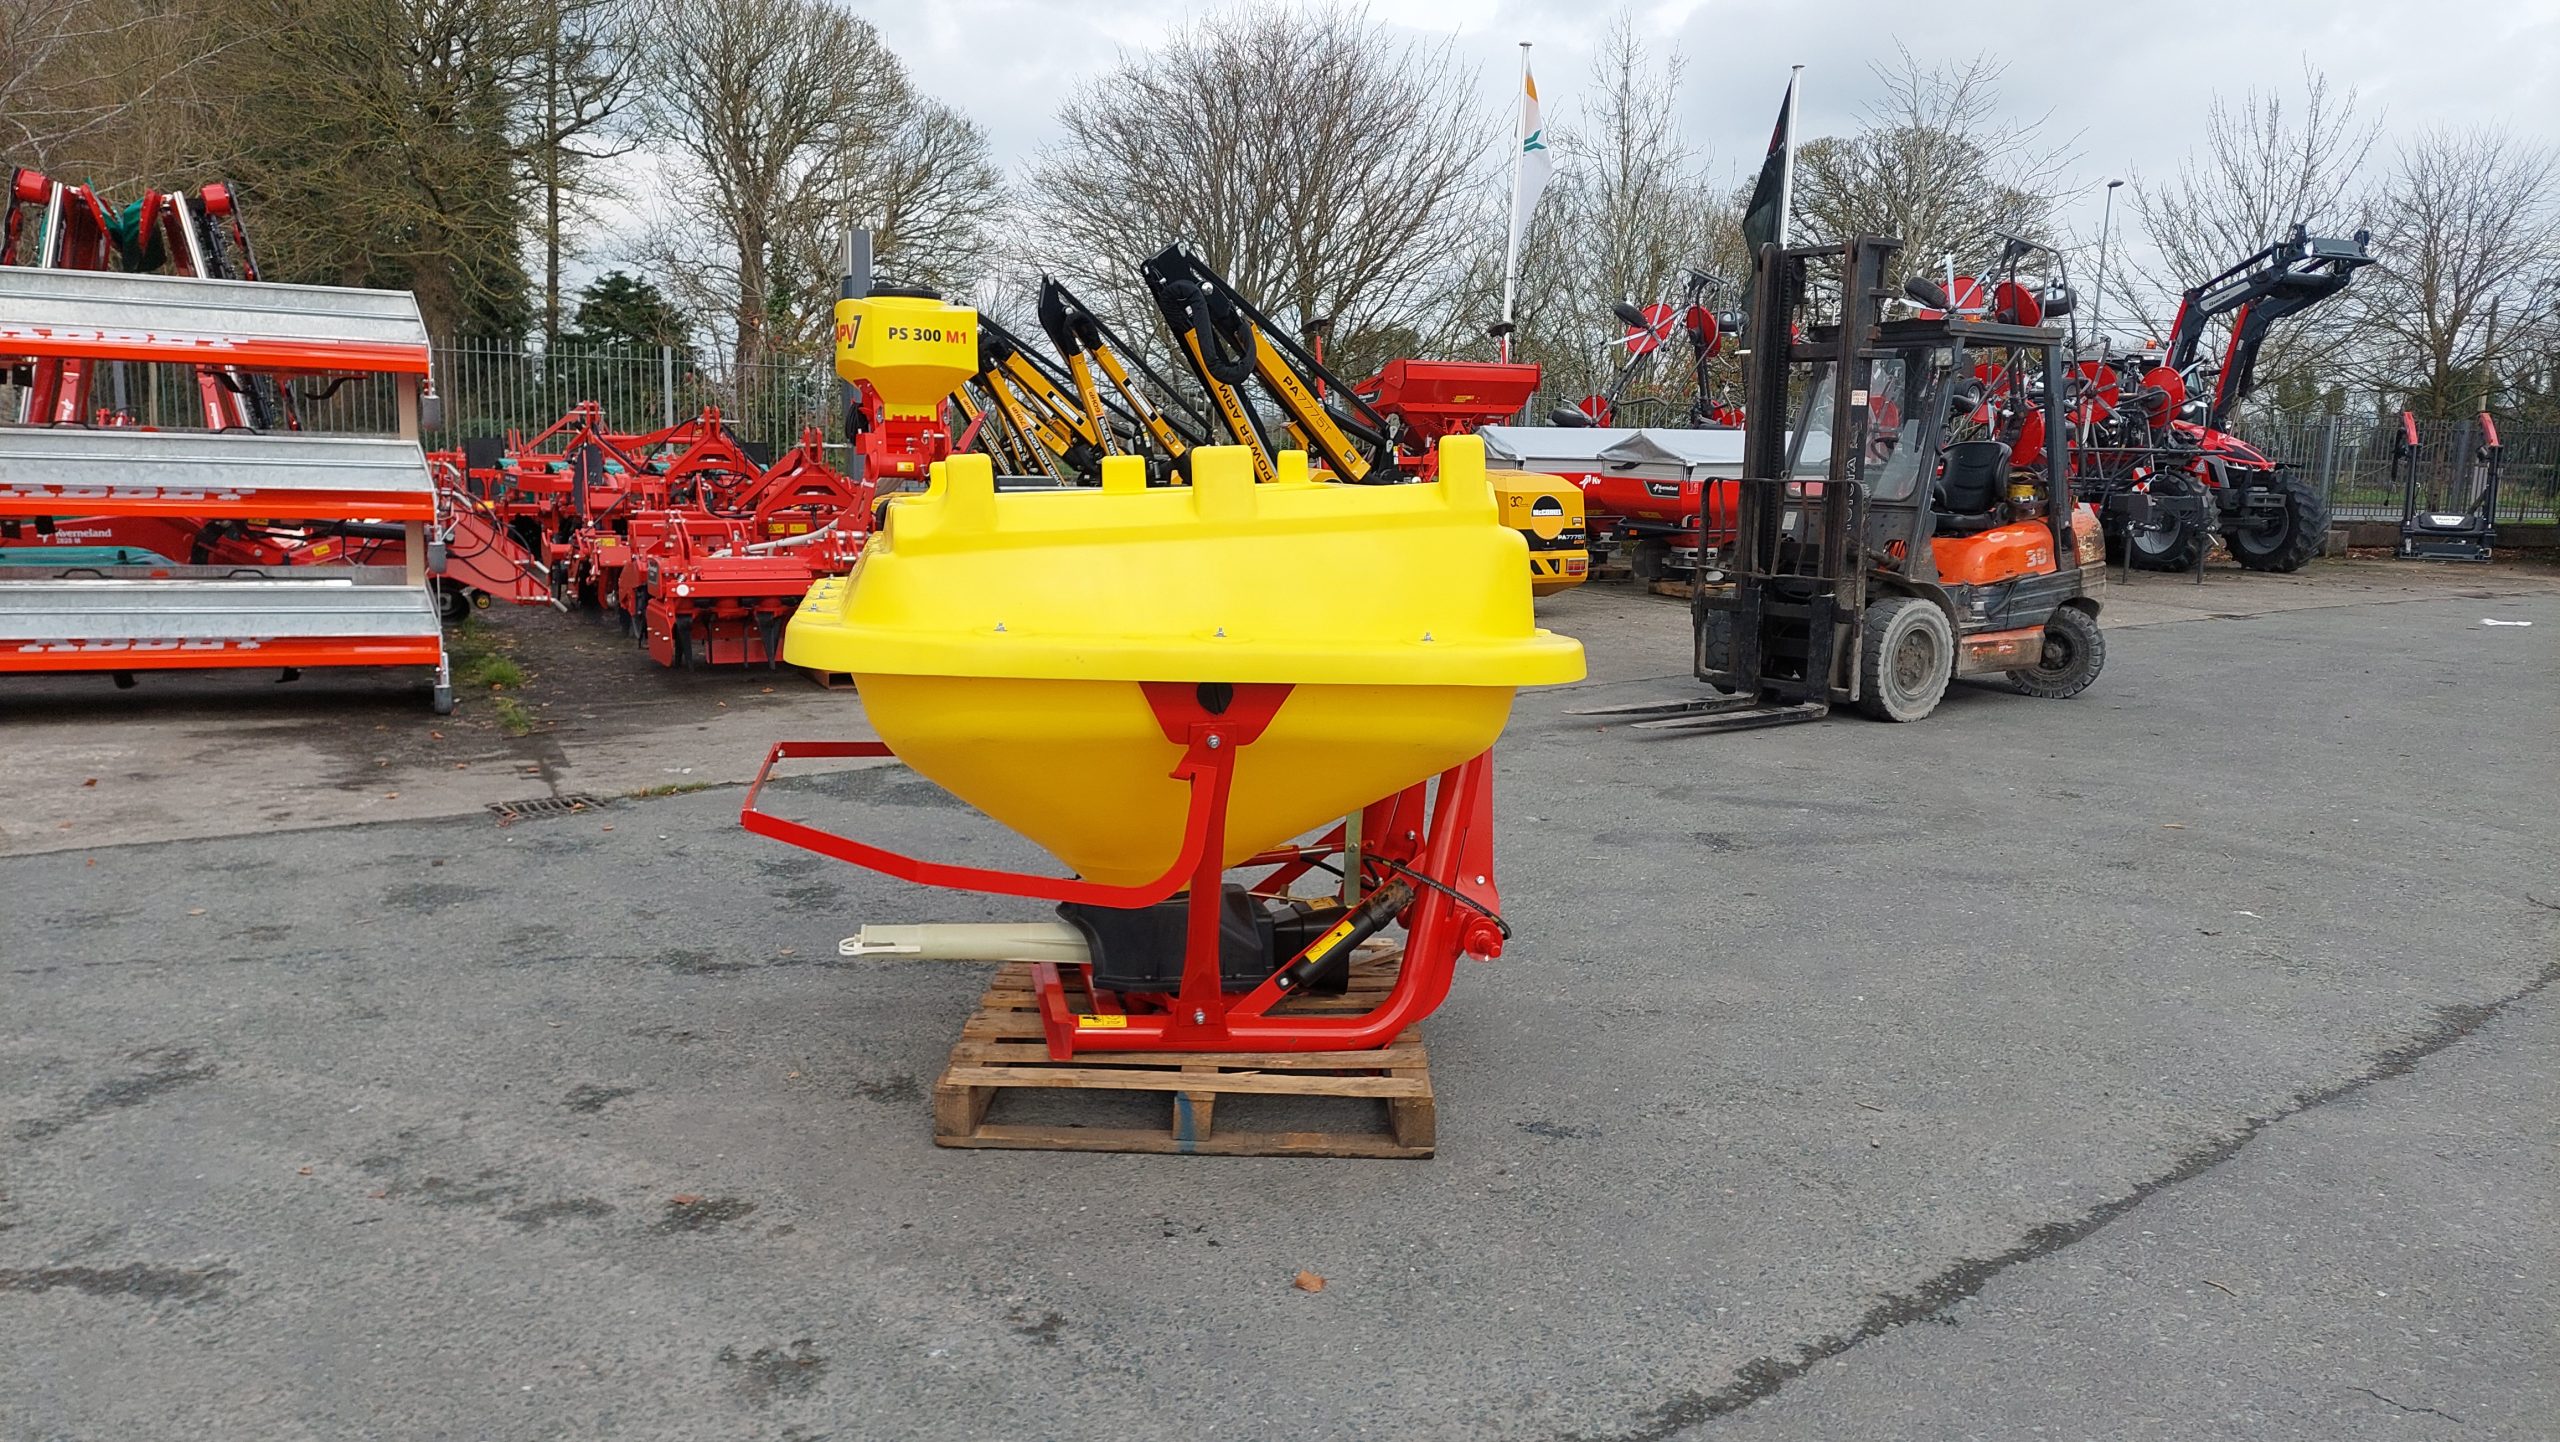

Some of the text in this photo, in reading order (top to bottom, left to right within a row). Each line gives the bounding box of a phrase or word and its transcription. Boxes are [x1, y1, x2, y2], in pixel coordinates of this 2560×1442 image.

[888, 327, 967, 344] PS 300 M1
[1283, 376, 1332, 433] PA7775T
[1218, 384, 1273, 482] POWER ARM
[979, 426, 1013, 475] POWER ARM 656
[1036, 447, 1050, 466] ARM
[1045, 464, 1062, 487] OWER
[2025, 548, 2047, 568] 30
